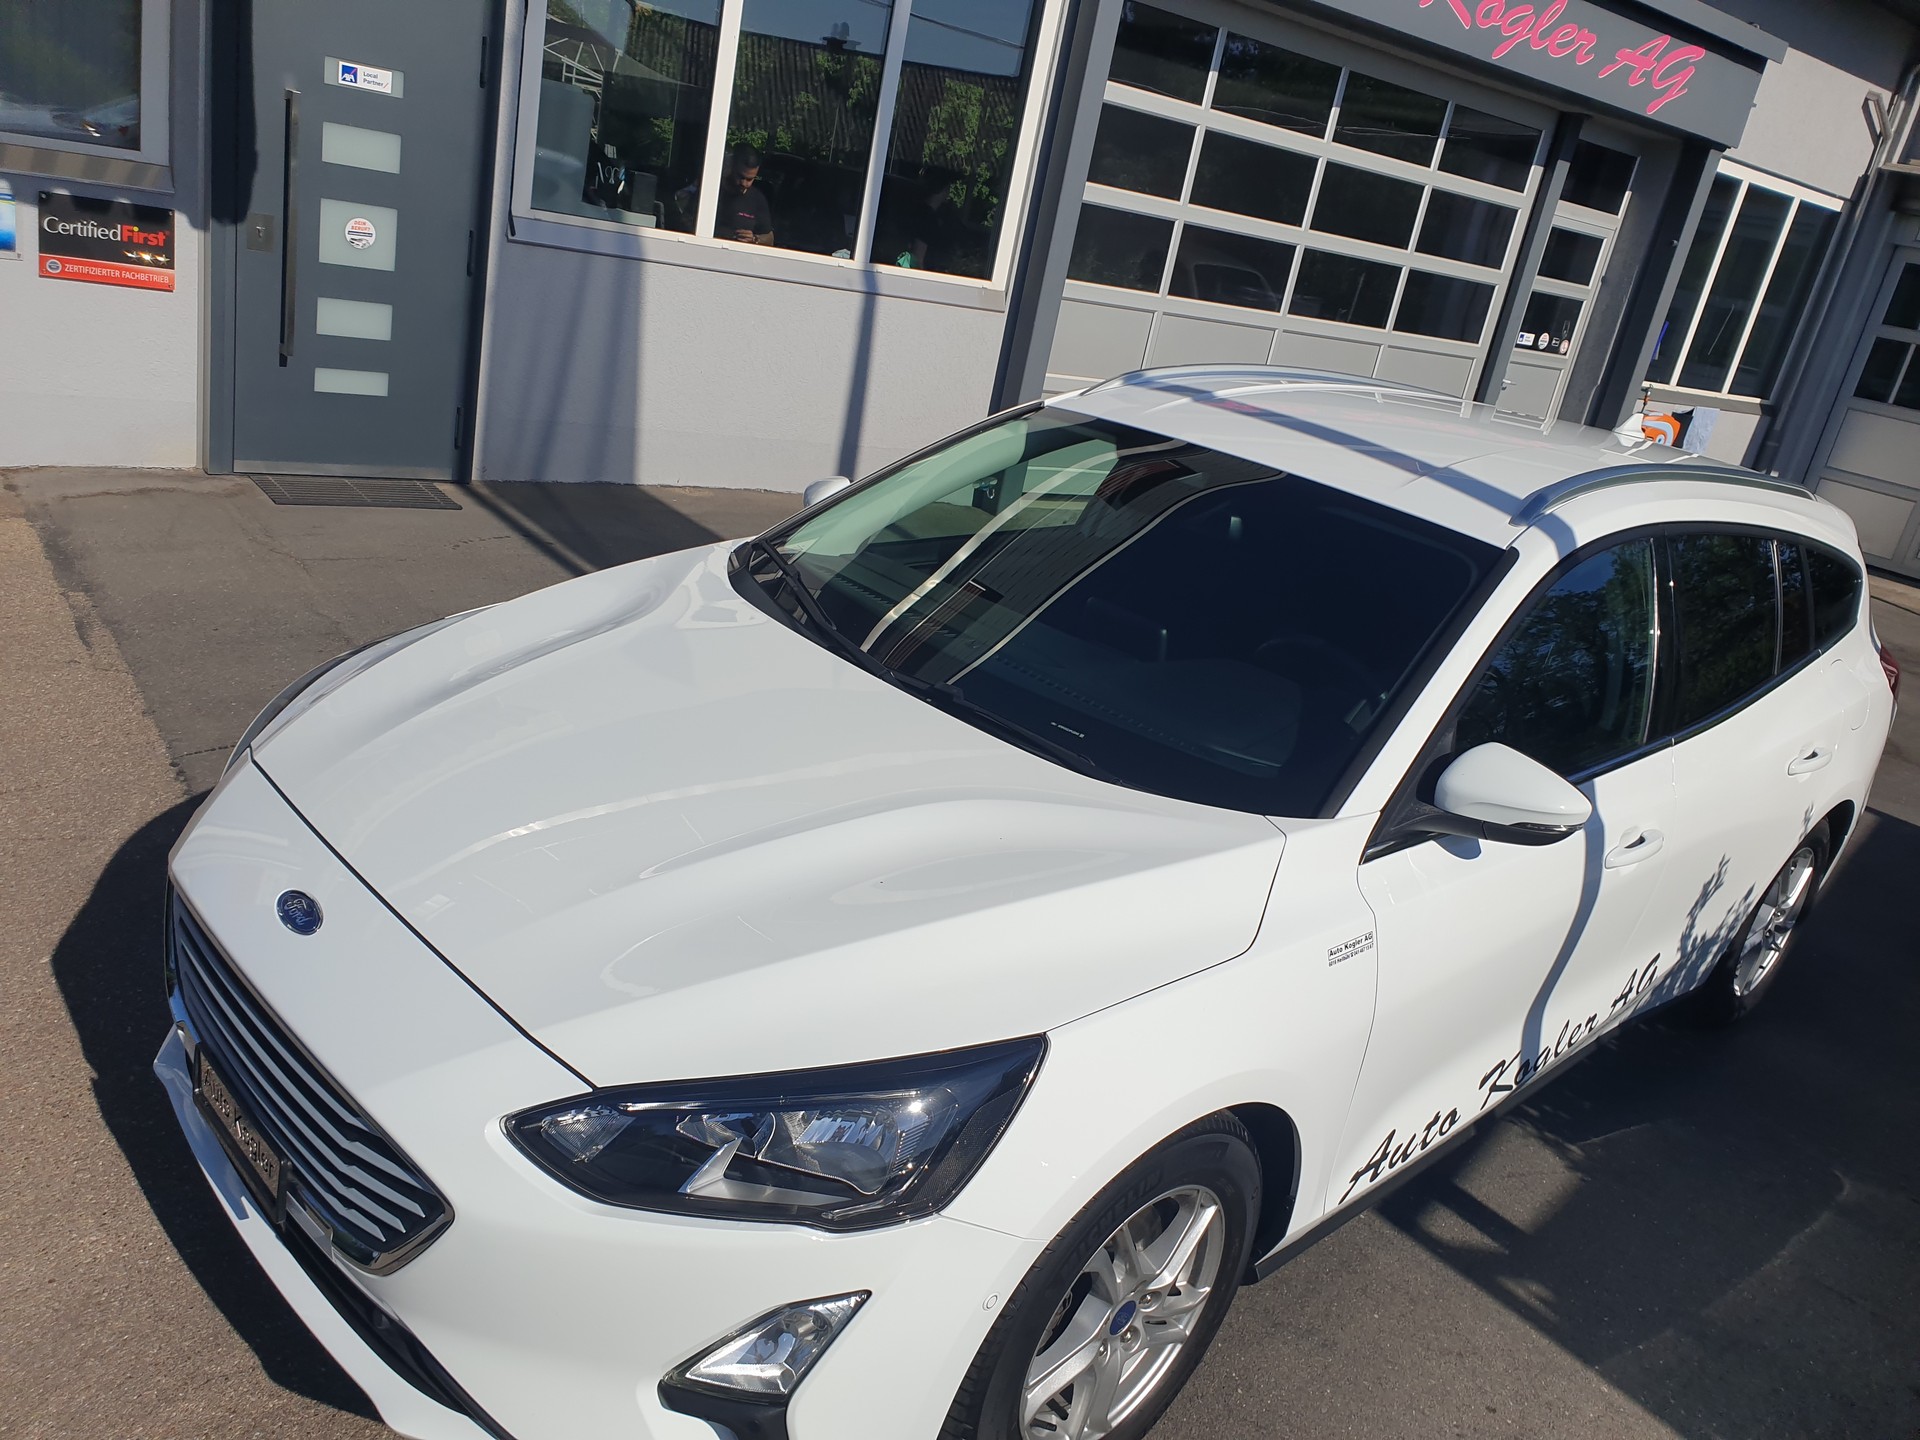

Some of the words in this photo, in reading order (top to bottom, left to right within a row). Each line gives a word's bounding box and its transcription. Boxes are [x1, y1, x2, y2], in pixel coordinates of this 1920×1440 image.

[362, 78, 384, 87] Partner
[363, 71, 379, 79] Local
[1598, 35, 1706, 114] AG
[64, 263, 121, 279] ZERTIFIZIERTER
[121, 270, 169, 284] FACHBETRIEB
[1329, 947, 1343, 957] Auto
[1344, 939, 1363, 950] Kogler
[1364, 933, 1373, 941] AG
[1338, 1108, 1461, 1205] Auto
[1607, 952, 1661, 1020] AG
